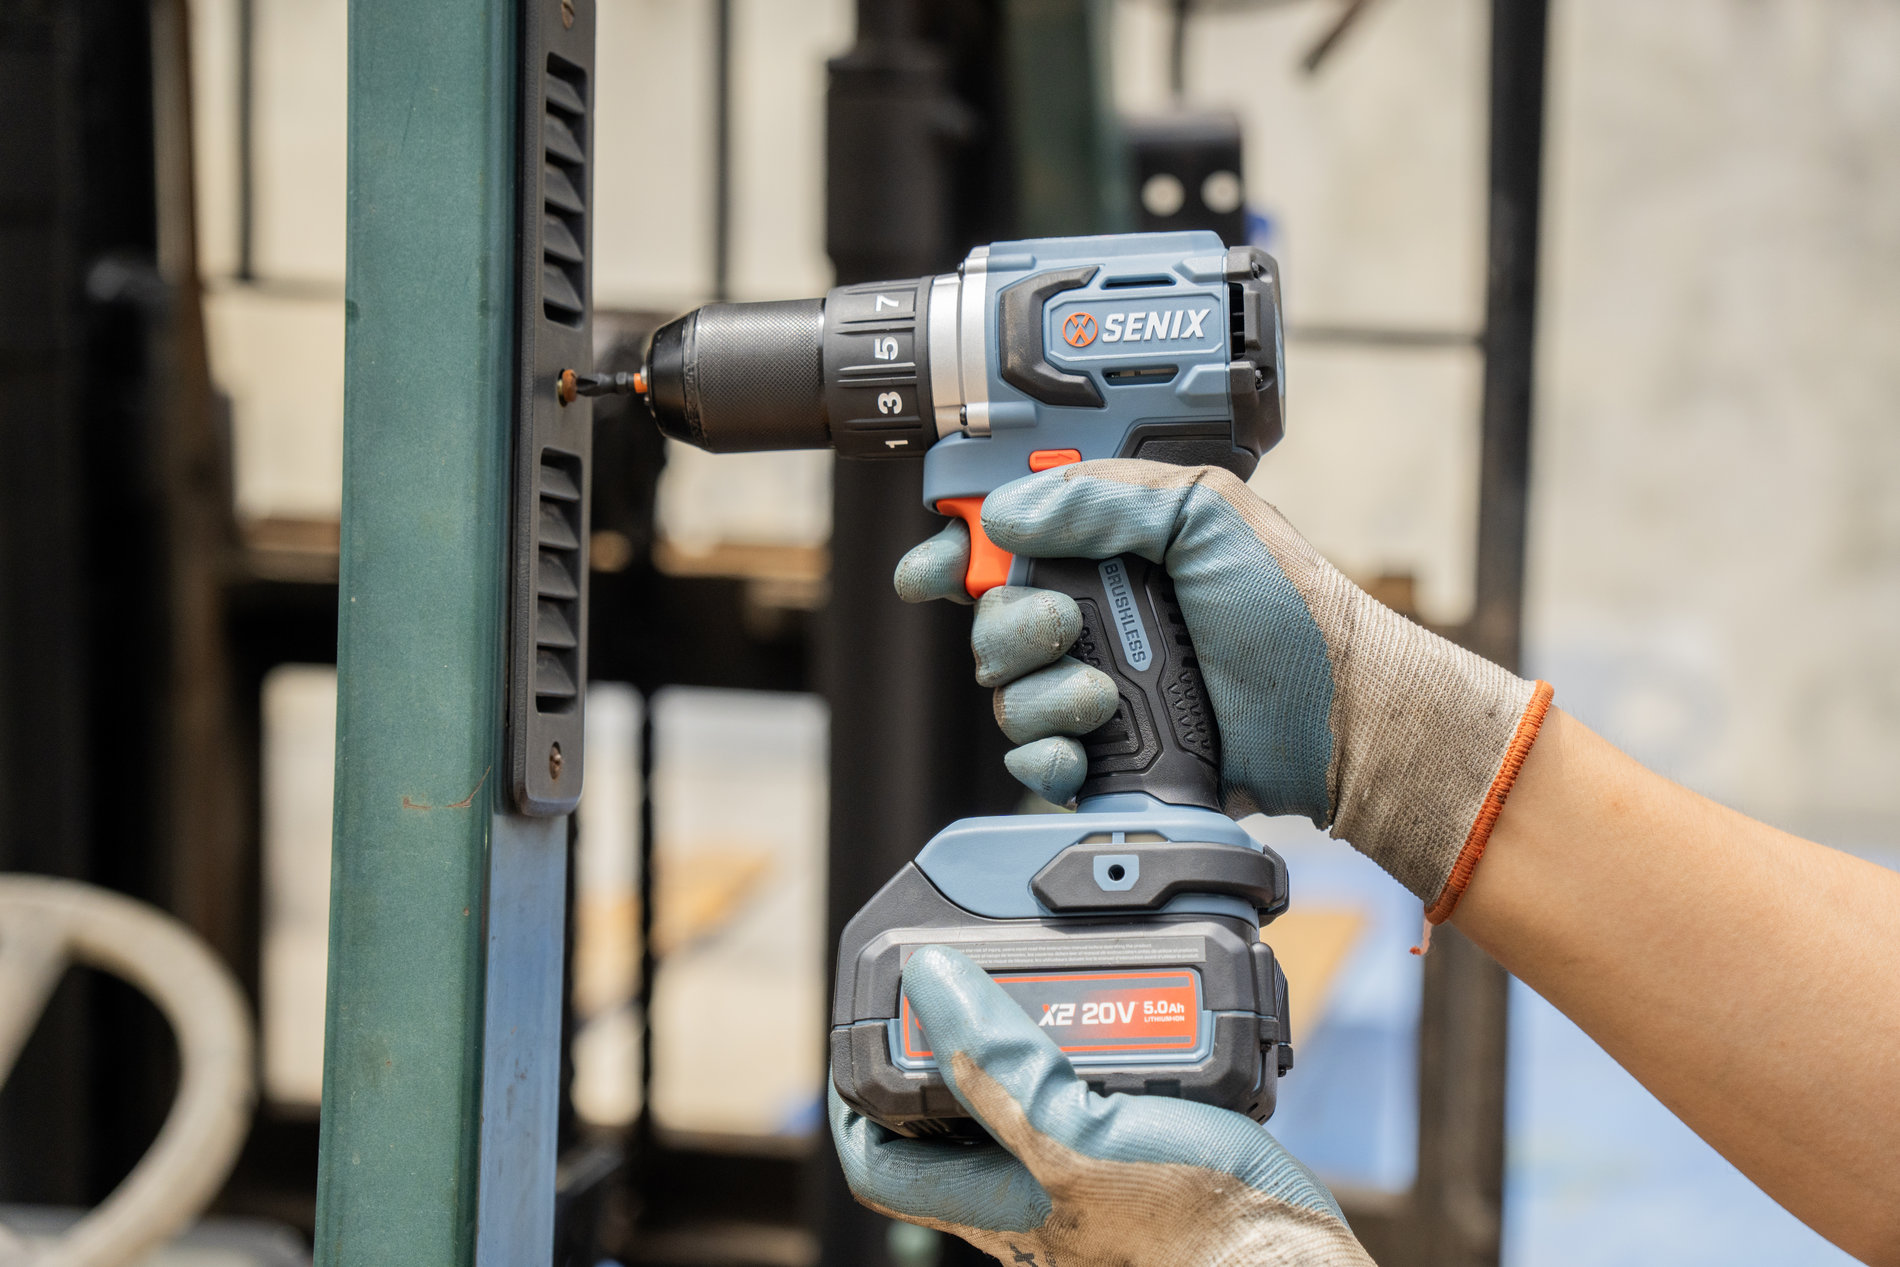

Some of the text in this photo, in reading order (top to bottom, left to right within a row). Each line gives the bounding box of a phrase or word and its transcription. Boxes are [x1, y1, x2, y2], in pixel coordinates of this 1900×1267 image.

[875, 295, 899, 312] 7
[1102, 308, 1211, 343] SENIX
[874, 336, 898, 360] 5
[877, 391, 902, 414] 3
[885, 439, 908, 448] 1
[1104, 563, 1146, 663] BRUSHLESS
[1038, 1000, 1185, 1026] X2 20V 5.0Ah
